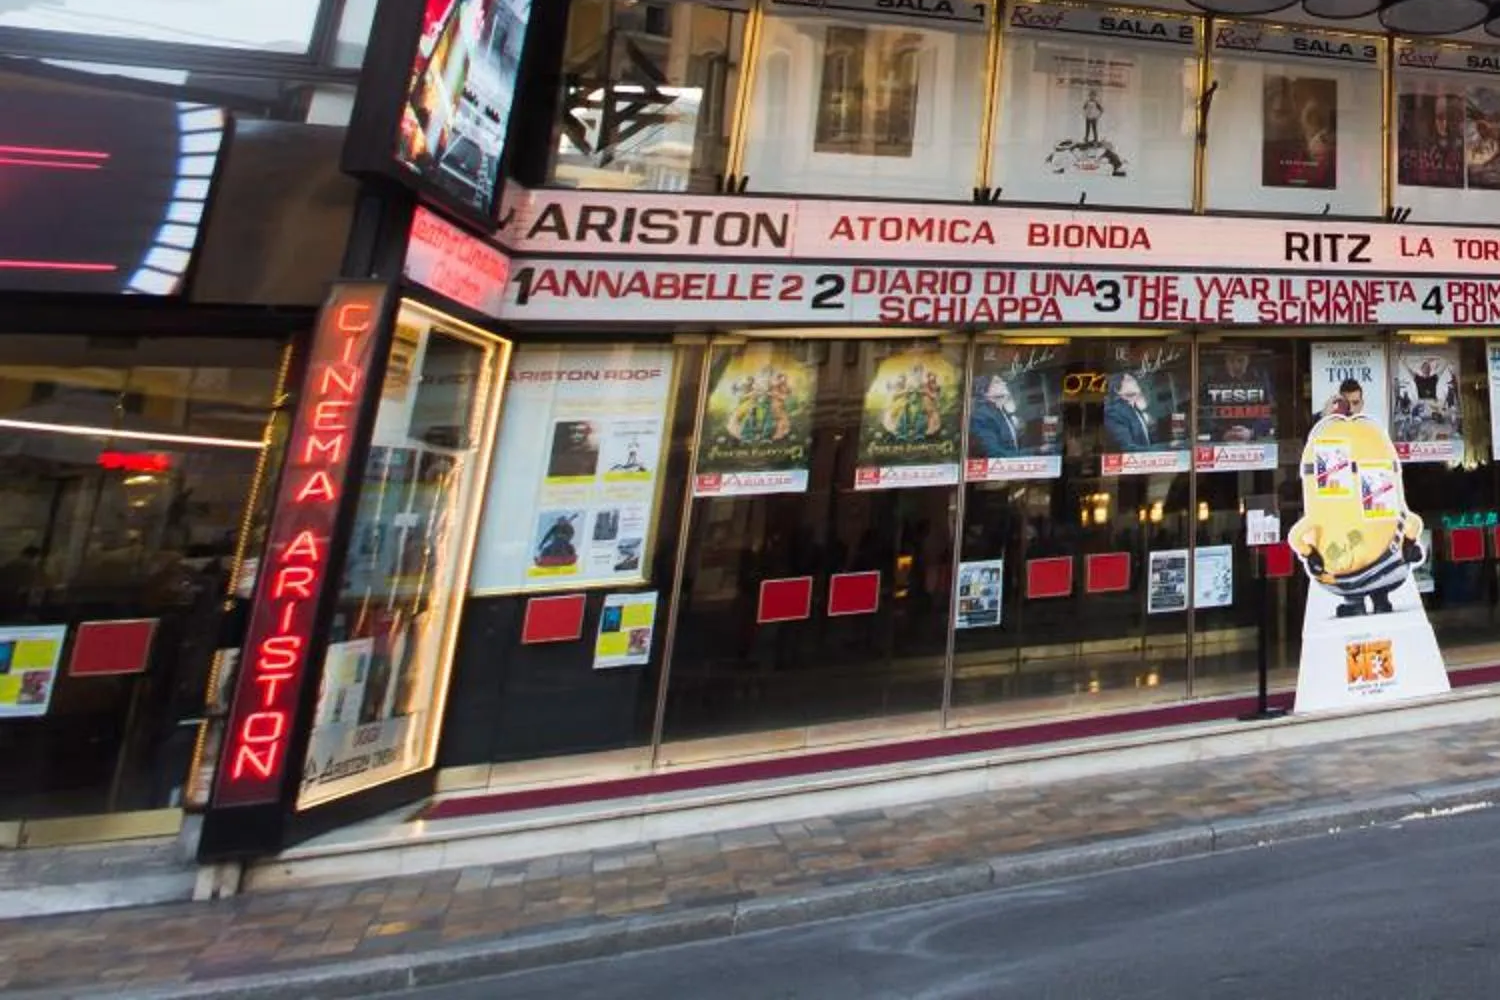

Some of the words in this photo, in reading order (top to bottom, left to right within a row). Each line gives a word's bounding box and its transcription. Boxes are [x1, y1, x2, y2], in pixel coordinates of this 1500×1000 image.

[972, 5, 985, 20] 1
[1010, 4, 1068, 28] Roof
[1101, 16, 1168, 37] SALA
[1176, 24, 1195, 39] 2
[1293, 36, 1354, 56] SALA
[1362, 44, 1378, 59] 3
[527, 202, 789, 248] ARISTON
[829, 214, 996, 245] ATOMICA
[1027, 223, 1151, 250] BIONDA
[1285, 231, 1372, 264] RITZ
[1401, 235, 1434, 258] LA
[512, 267, 535, 305] 1
[530, 268, 772, 301] ANNABELLE
[778, 275, 805, 301] 2
[811, 273, 846, 310] 2
[851, 268, 970, 297] DIARIO
[983, 271, 1015, 297] DI
[1030, 272, 1097, 299] UNA
[1094, 279, 1121, 313] 3
[1122, 275, 1179, 300] THE
[1195, 276, 1269, 301] WAR
[1279, 278, 1302, 301] IL
[1305, 279, 1416, 303] PIANETA
[1421, 285, 1445, 316] 4
[878, 294, 1063, 324] SCHIAPPA
[1139, 297, 1235, 323] DELLE
[1257, 300, 1379, 325] SCIMMIE
[509, 368, 600, 382] ARISTON
[1325, 367, 1373, 382] TOUR
[296, 303, 371, 501] CINEMA
[231, 530, 320, 780] ARISTON
